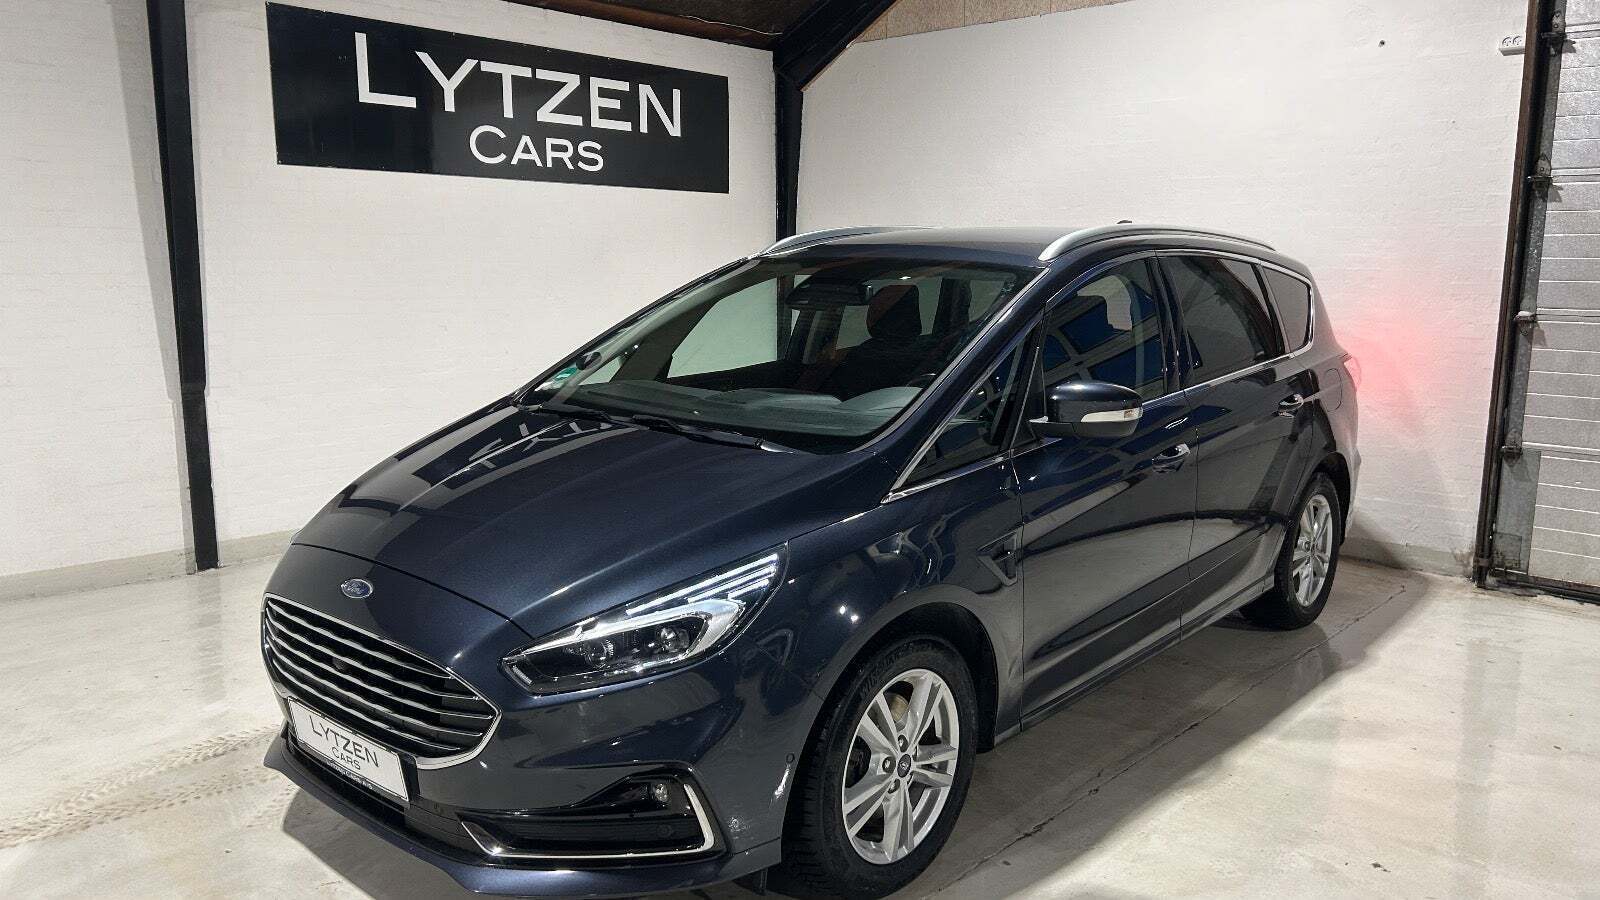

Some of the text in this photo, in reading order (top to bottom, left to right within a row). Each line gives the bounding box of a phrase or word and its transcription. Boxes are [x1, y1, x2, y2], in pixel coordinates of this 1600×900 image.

[354, 32, 681, 137] LYTZEN
[470, 125, 604, 172] CARS
[309, 715, 379, 768] LYTZEN
[332, 746, 361, 770] CARS
